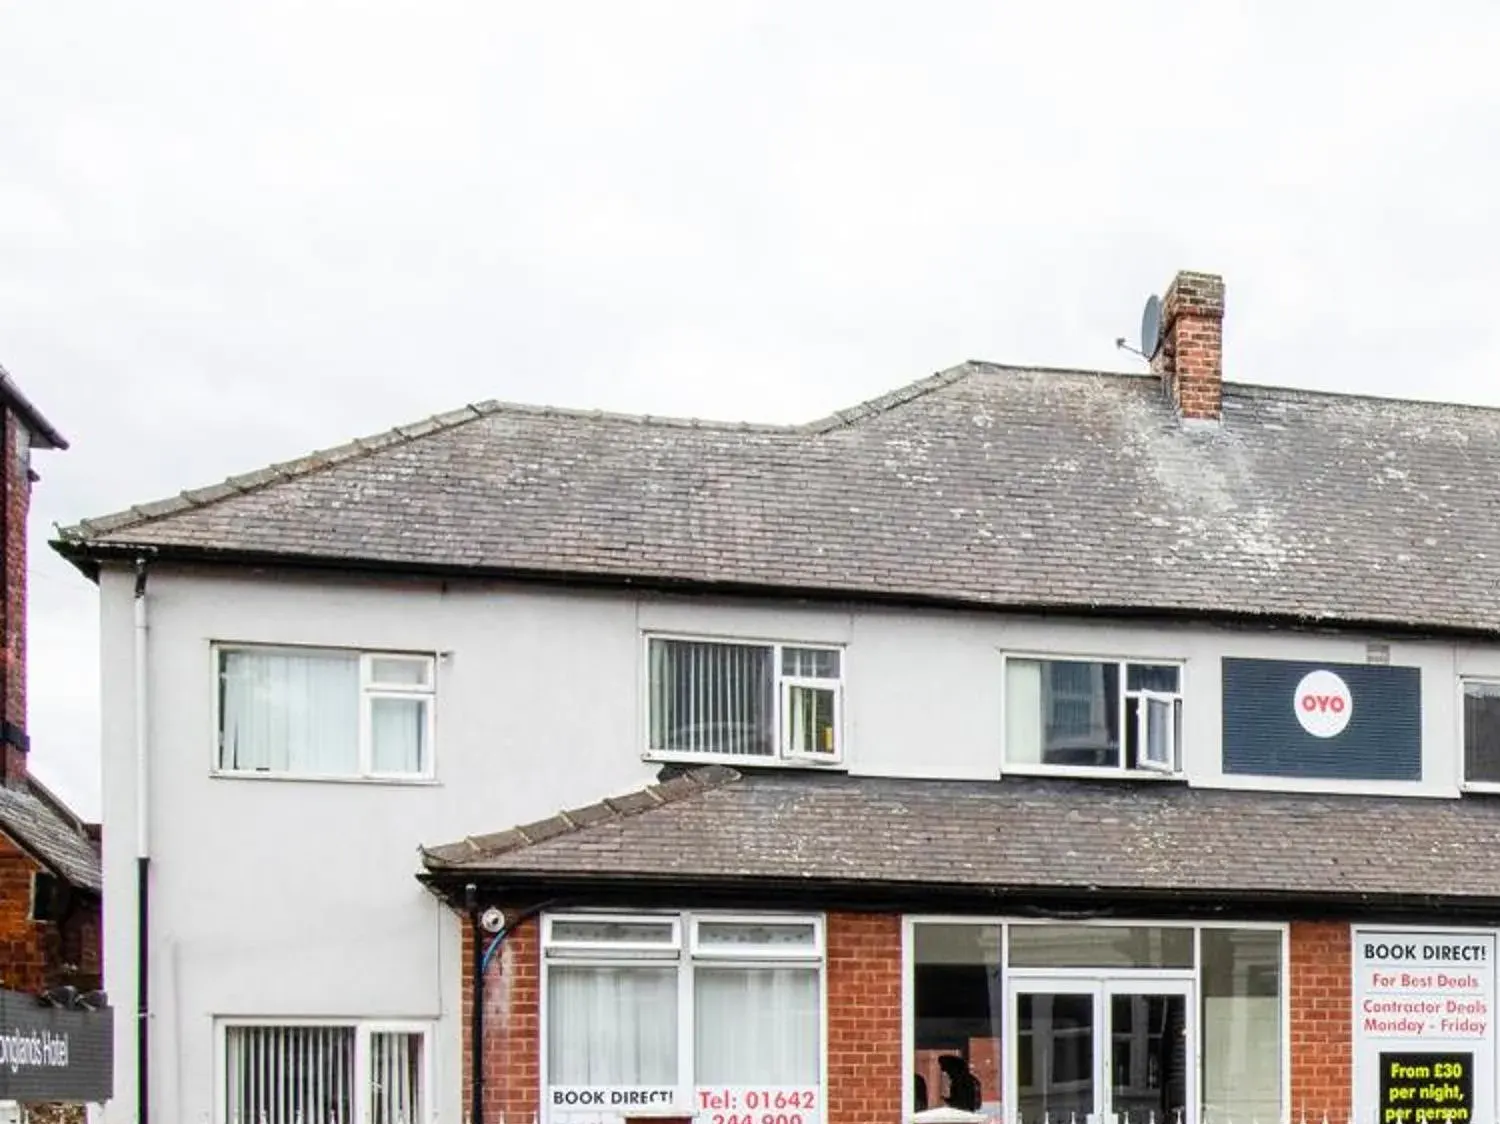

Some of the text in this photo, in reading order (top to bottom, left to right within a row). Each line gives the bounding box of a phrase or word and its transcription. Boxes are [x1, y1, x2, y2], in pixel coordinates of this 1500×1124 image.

[1302, 694, 1345, 712] OYO
[1364, 944, 1487, 961] BOOK DIRECT!
[1372, 973, 1479, 988] For Best Deals
[1363, 1000, 1487, 1014] Contractor Deals
[1363, 1018, 1425, 1034] Monday
[1440, 1018, 1487, 1035] Friday
[1391, 1063, 1463, 1078] From £30
[553, 1091, 673, 1105] BOOK DIRECT!
[699, 1089, 815, 1110] Tel: 01642
[1389, 1084, 1464, 1102] per night,
[1385, 1108, 1468, 1123] per person
